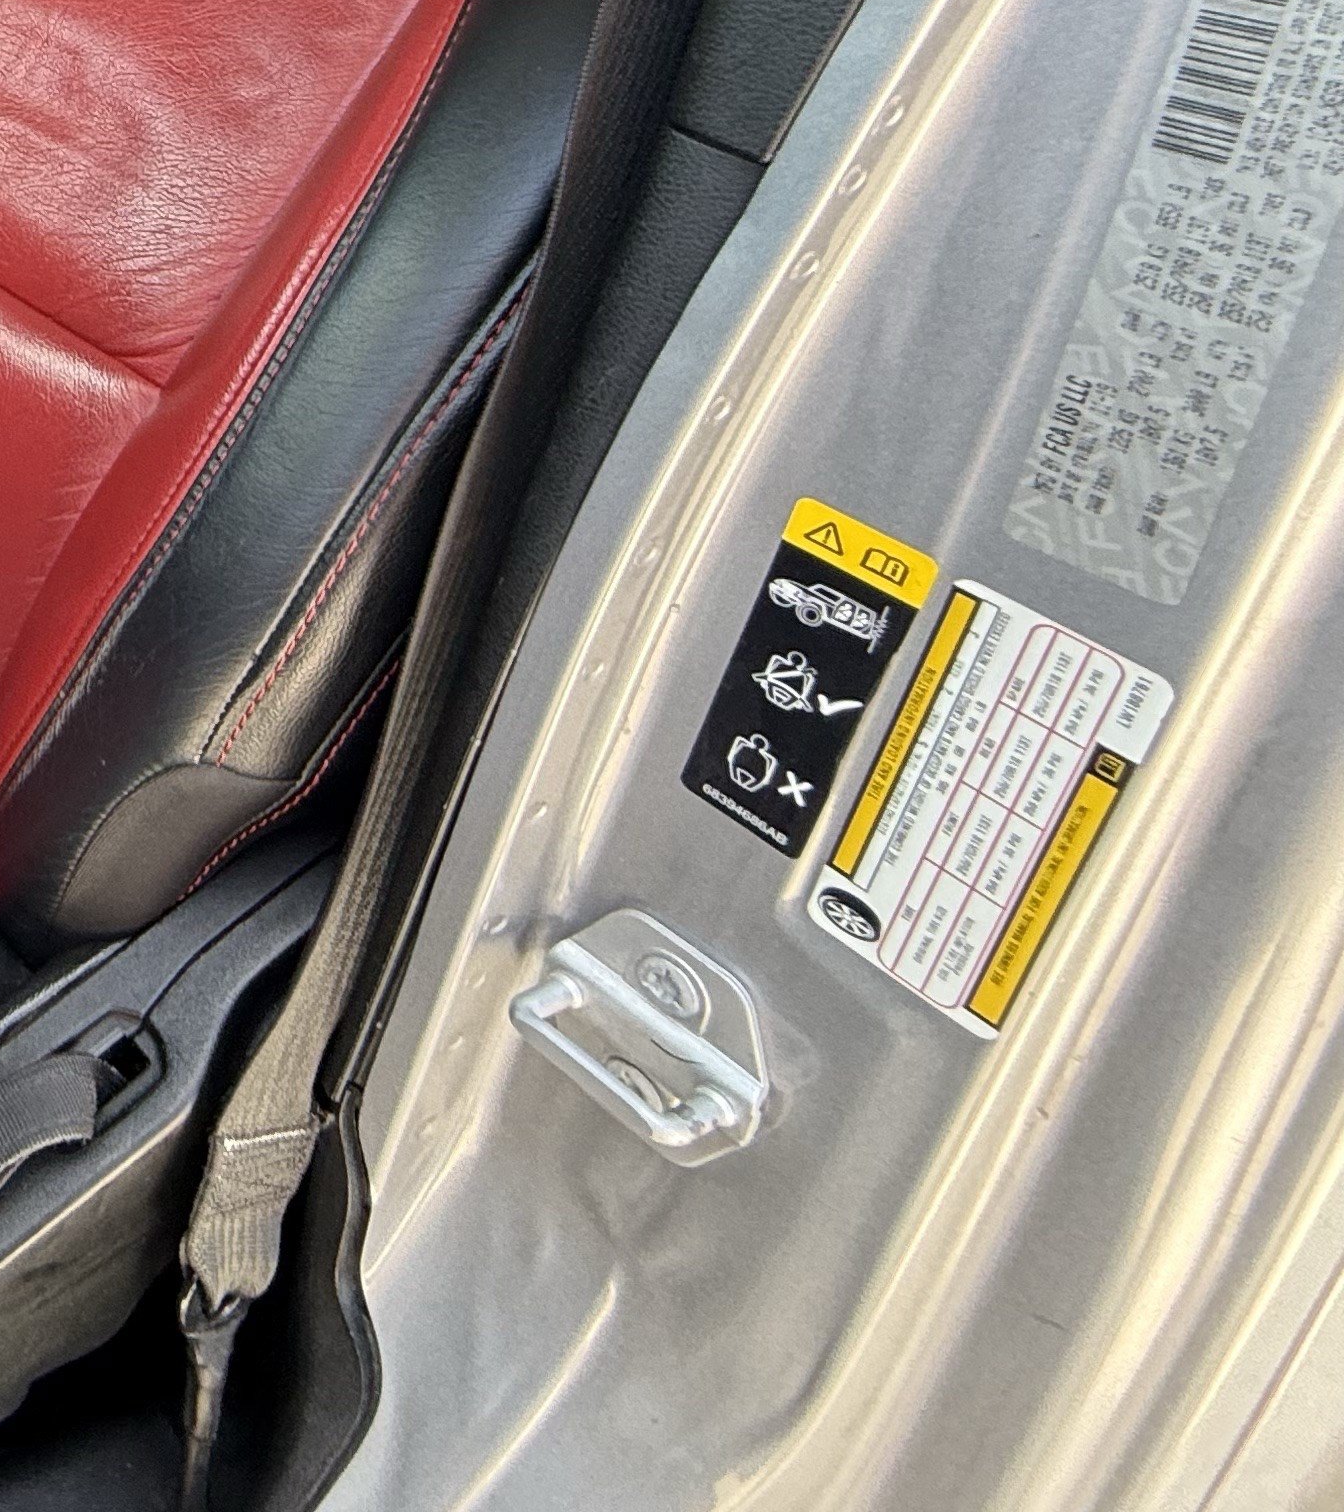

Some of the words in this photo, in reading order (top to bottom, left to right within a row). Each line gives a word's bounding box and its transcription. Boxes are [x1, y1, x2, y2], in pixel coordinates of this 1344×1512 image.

[1059, 372, 1093, 405] LLC
[1051, 400, 1083, 428] US
[1040, 422, 1074, 457] FCA
[876, 758, 893, 782] AND
[900, 663, 938, 727] INFORMATION
